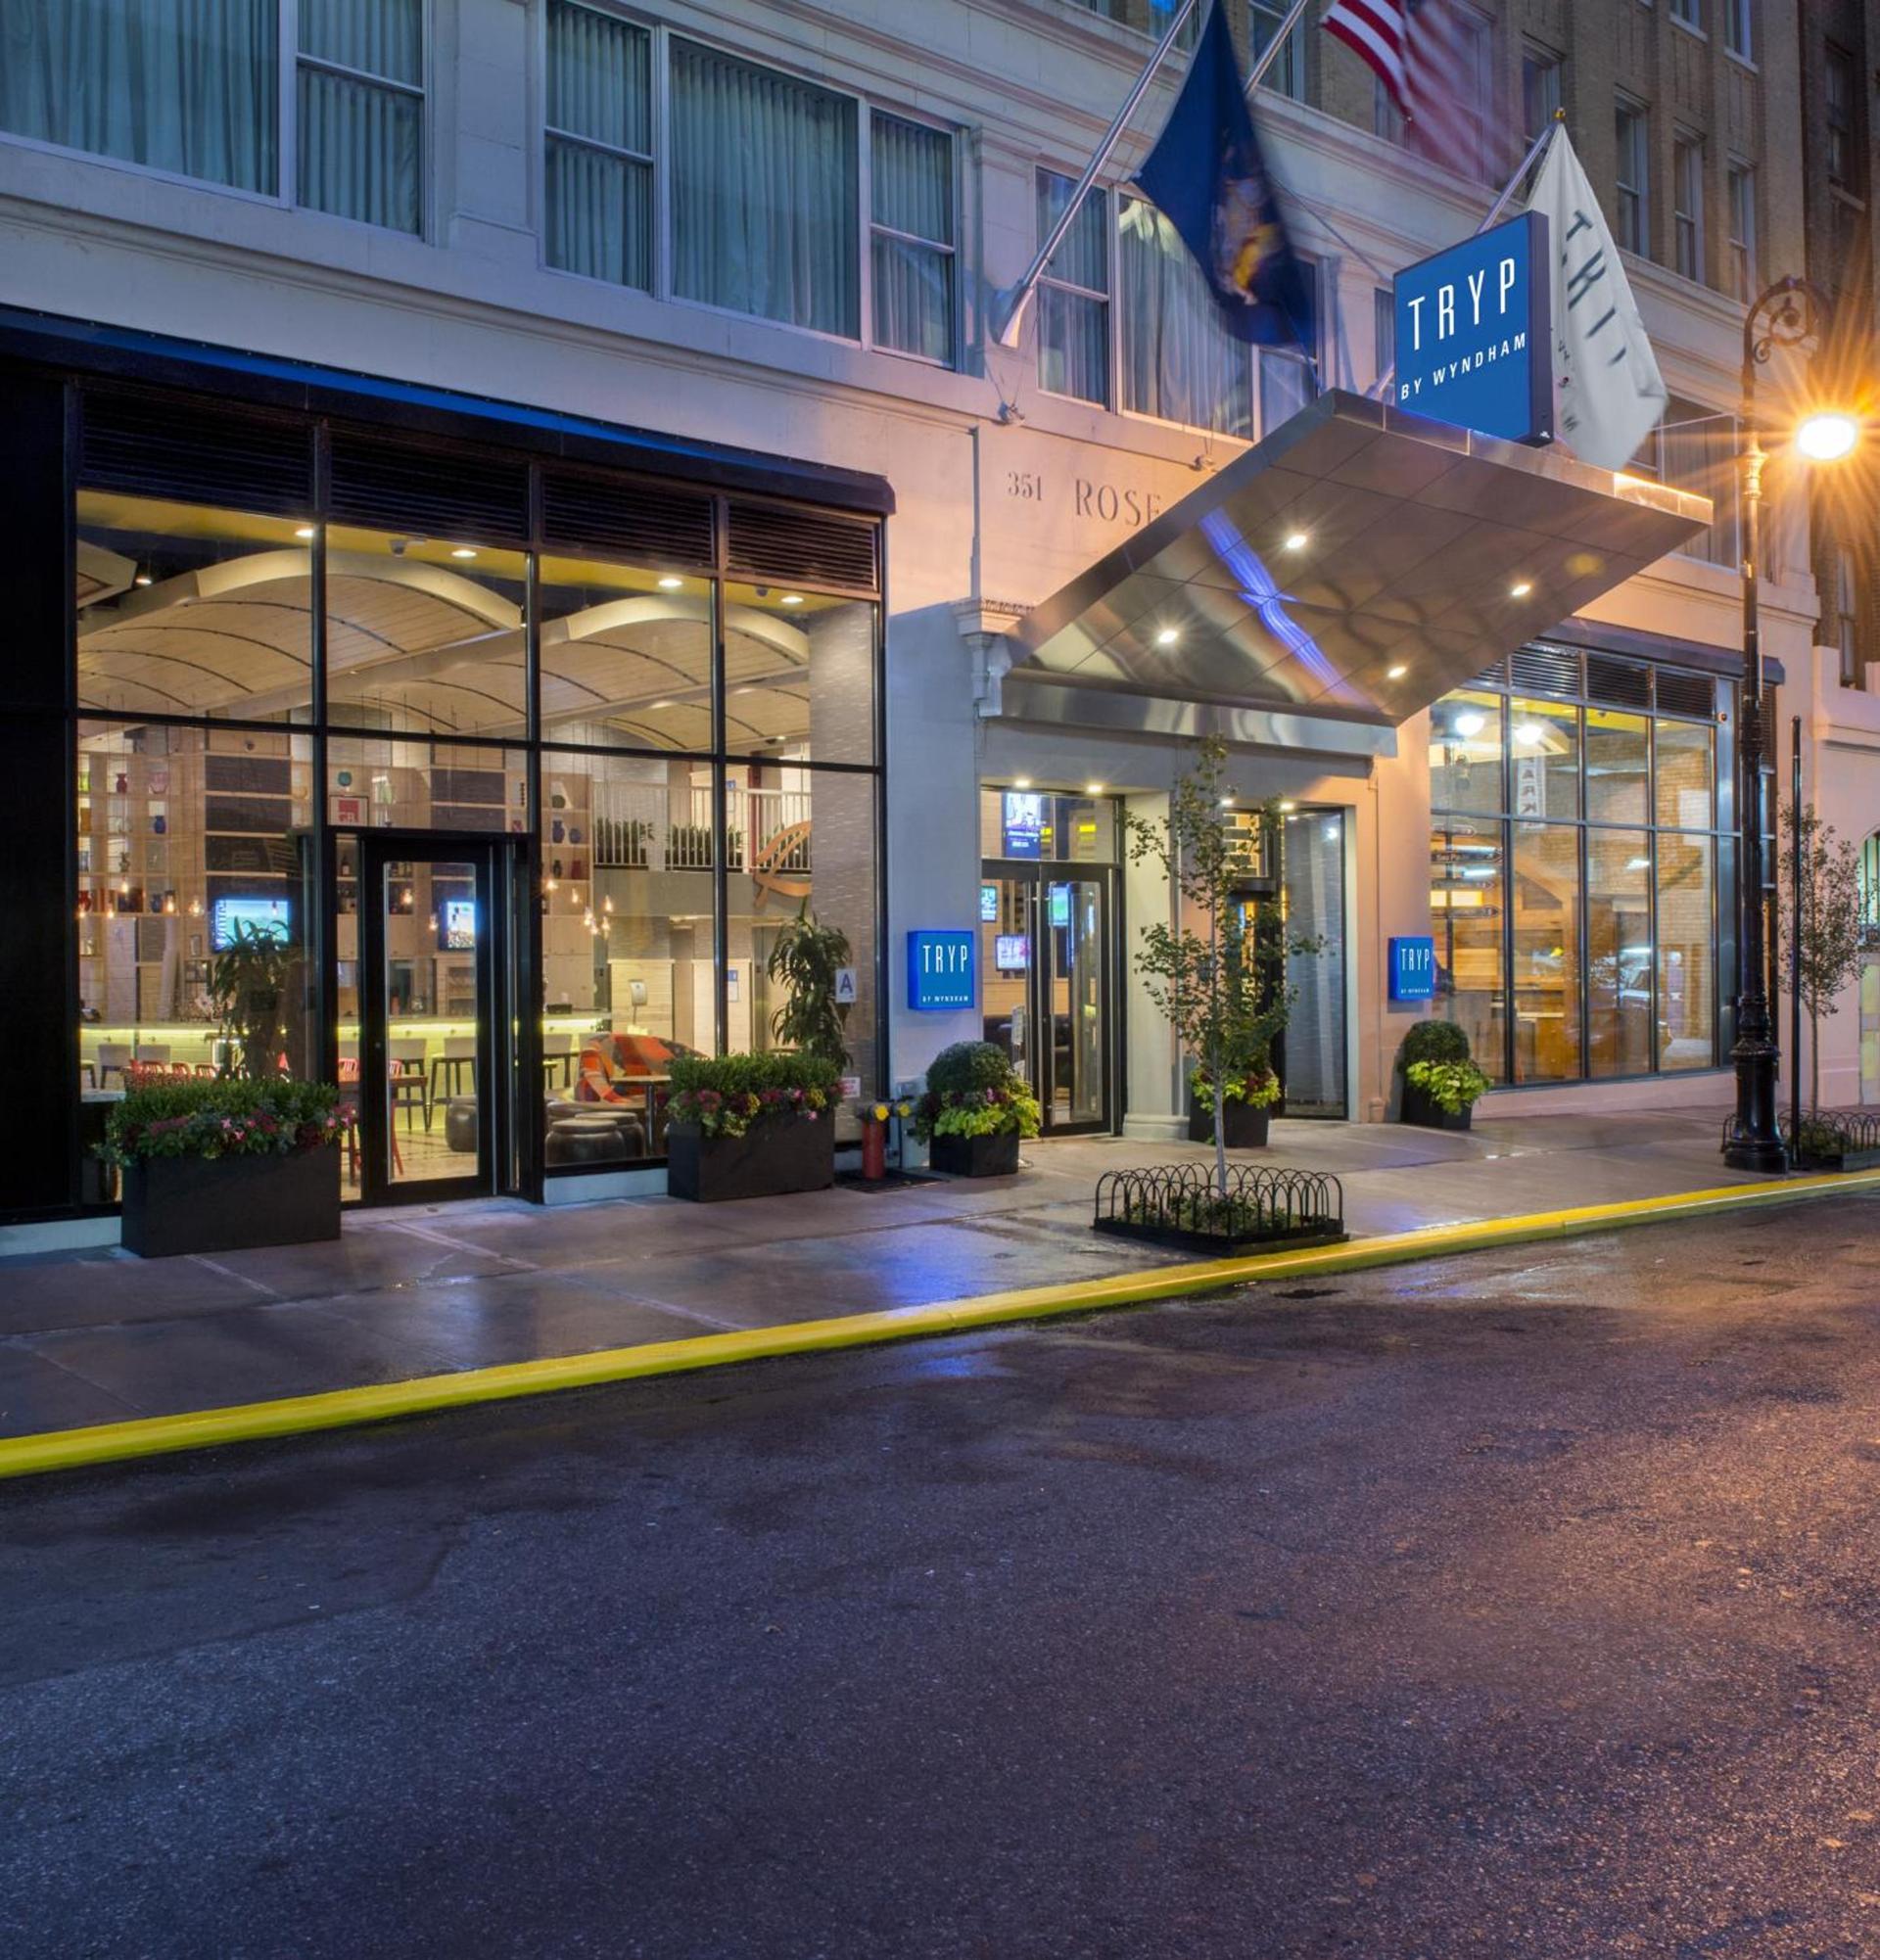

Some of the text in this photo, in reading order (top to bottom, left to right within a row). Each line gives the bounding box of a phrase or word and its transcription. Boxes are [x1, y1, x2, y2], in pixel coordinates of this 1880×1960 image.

[1408, 257, 1516, 351] TRYP
[1401, 377, 1423, 400] BY
[1433, 332, 1526, 387] WYNDHAM
[1008, 471, 1043, 501] 351
[922, 945, 968, 974] TRYP
[1401, 948, 1430, 971] TRYP
[839, 973, 854, 995] A
